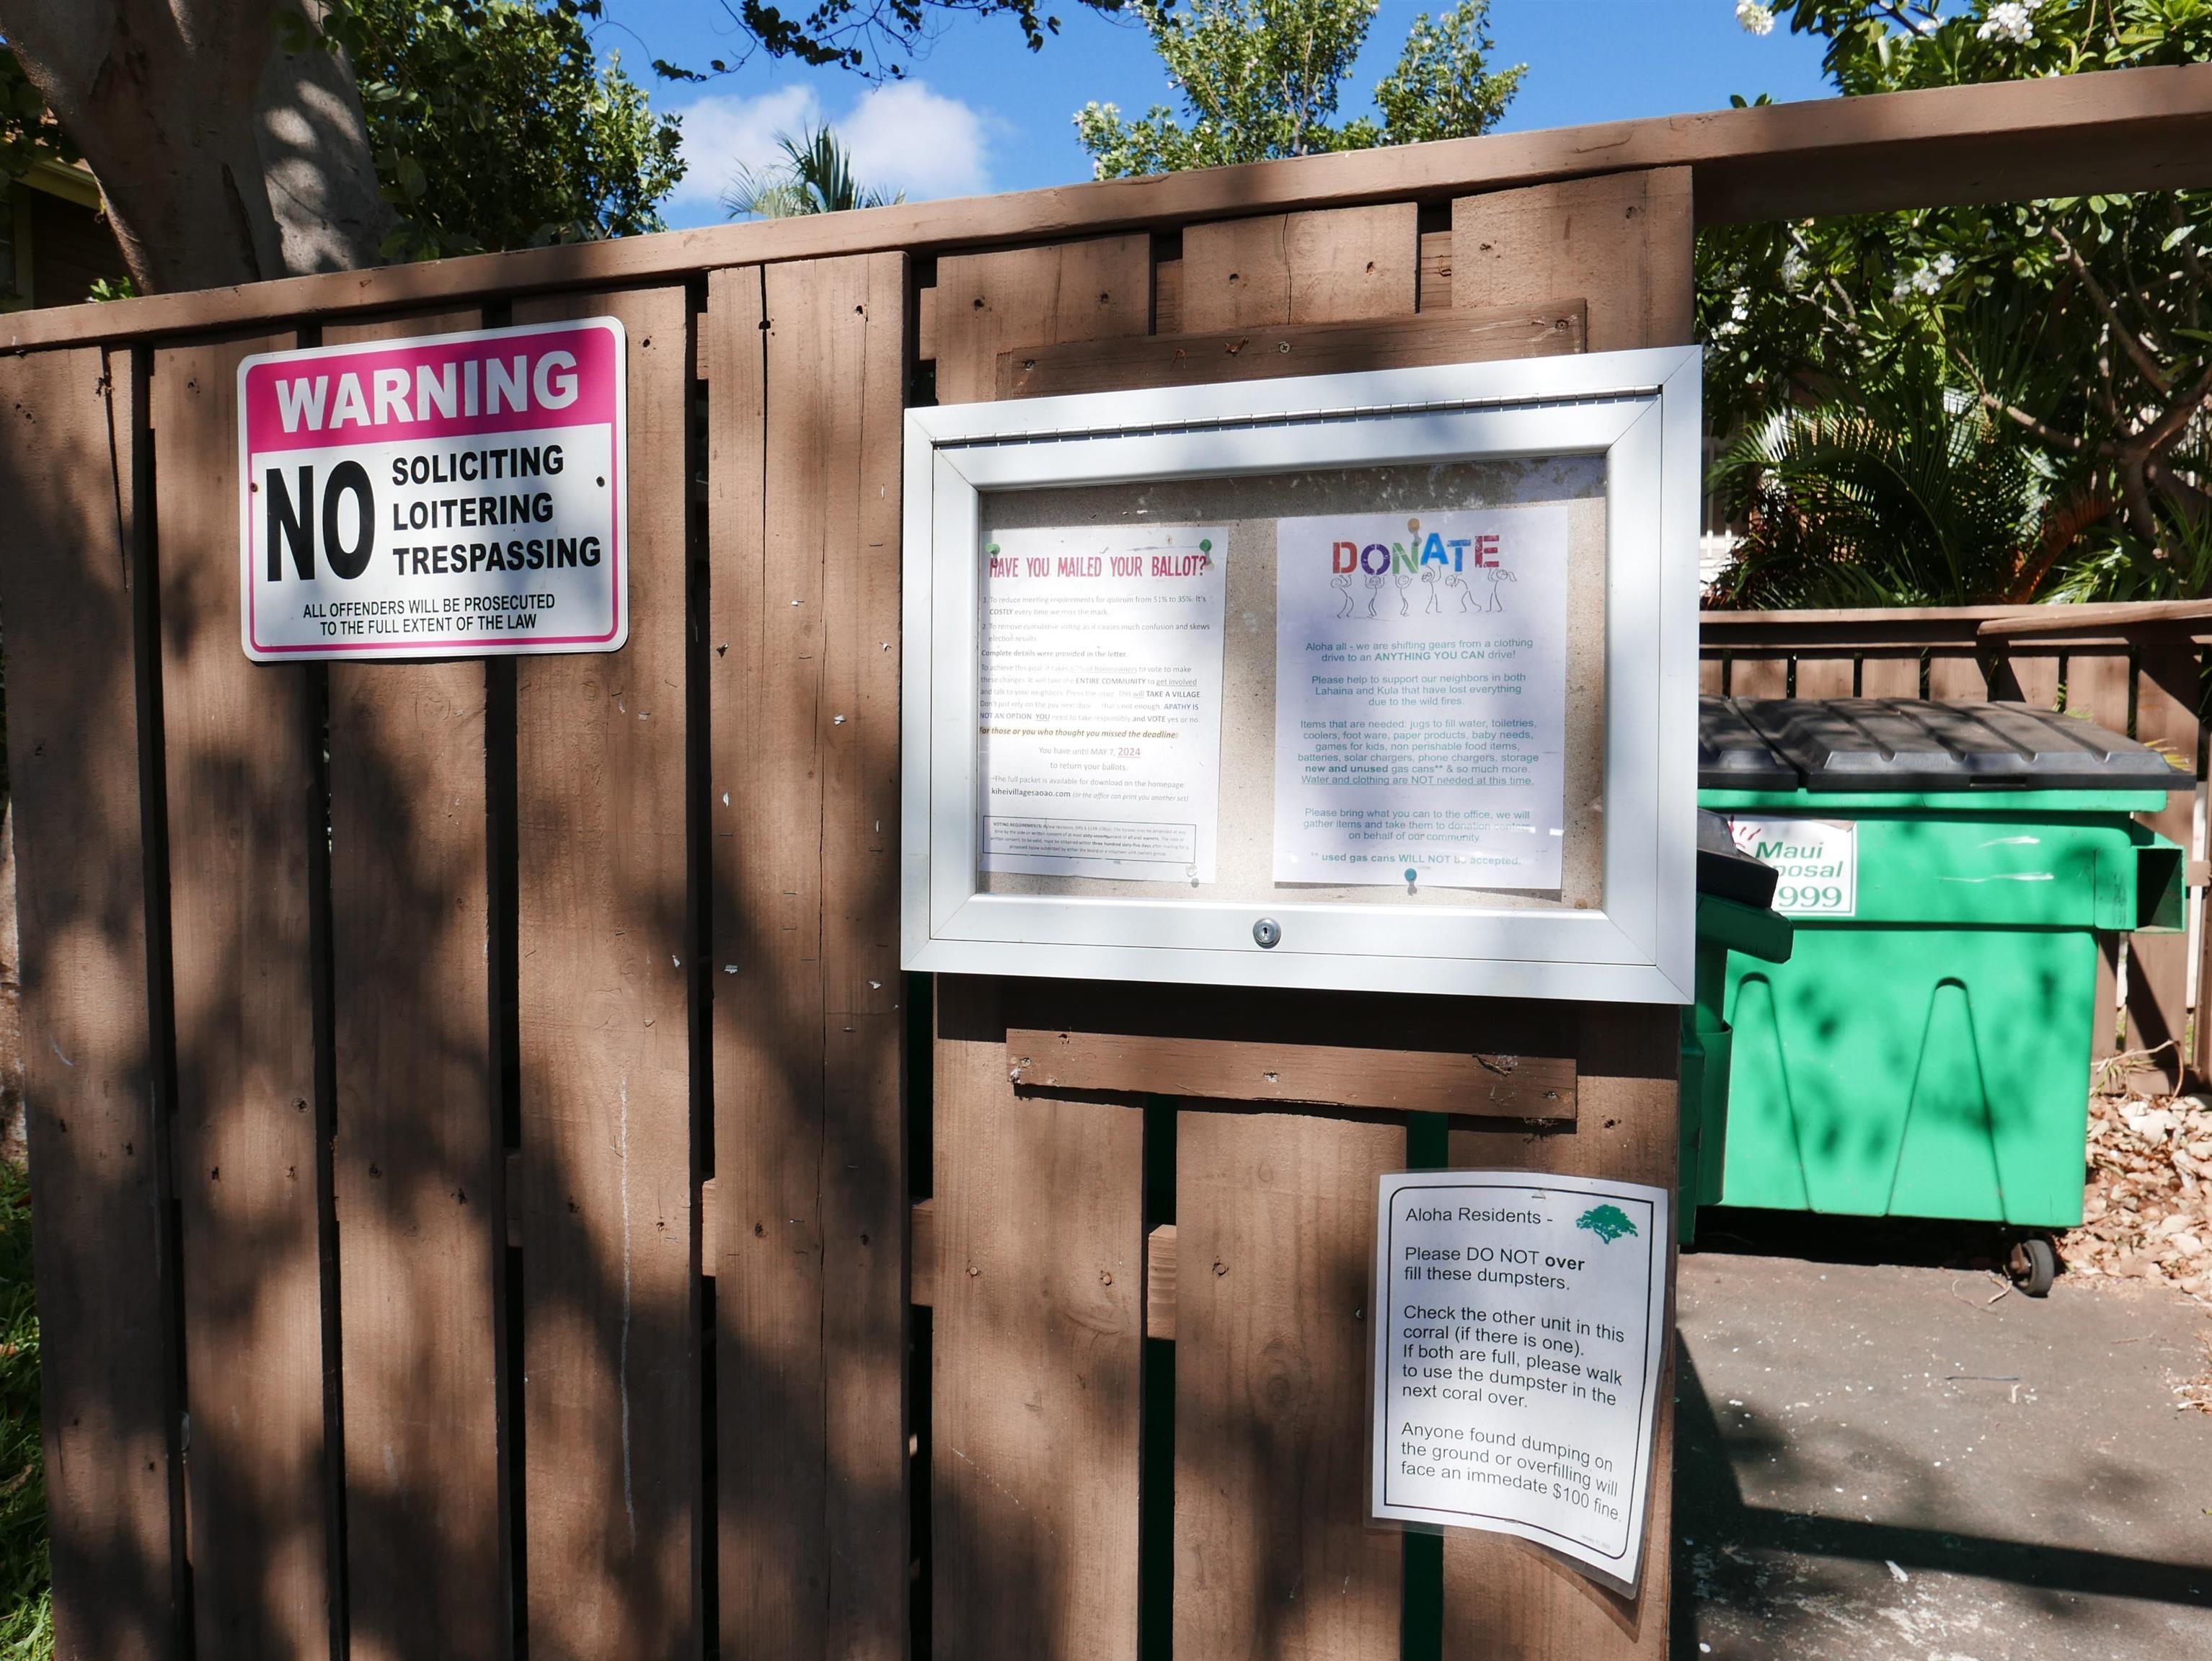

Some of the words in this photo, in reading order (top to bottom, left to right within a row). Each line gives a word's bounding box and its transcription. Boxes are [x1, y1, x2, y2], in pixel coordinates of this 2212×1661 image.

[275, 350, 578, 433] WARNING
[392, 445, 563, 486] SOLICITING
[266, 460, 375, 581] NO
[393, 492, 553, 531] LOITERING
[393, 536, 601, 575] TRESPASSING
[1333, 533, 1500, 575] DONATE
[990, 557, 1018, 577] HAVE
[1027, 557, 1049, 577] YOU
[1058, 557, 1102, 577] MAILED
[1110, 557, 1142, 577] YOUR
[1154, 556, 1206, 576] BALLOT?
[303, 603, 327, 618] ALL
[329, 601, 404, 617] OFFENDERS
[408, 599, 439, 614] WILL
[443, 598, 460, 612] BE
[464, 594, 554, 611] PROSECUTED
[320, 621, 337, 636] TO
[340, 620, 364, 634] THE
[368, 619, 399, 634] FULL
[403, 617, 452, 632] EXTENT
[456, 616, 474, 631] OF
[477, 615, 503, 630] THE
[508, 614, 536, 629] LAW
[1306, 642, 1333, 652] Aloha
[1336, 642, 1347, 651] all
[1392, 641, 1425, 651] shifting
[1428, 642, 1456, 651] gears
[1459, 639, 1482, 649] from
[1494, 638, 1533, 649] clothing
[1322, 653, 1345, 662] drive
[1374, 652, 1430, 661] ANYTHING
[1433, 650, 1457, 660] YOU
[1461, 650, 1485, 659] CAN
[1488, 648, 1516, 659] drive!
[1311, 676, 1344, 684] Please
[1347, 676, 1368, 686] help
[1371, 676, 1380, 684] to
[1382, 675, 1419, 685] support
[1440, 673, 1489, 684] neighbors
[1492, 673, 1501, 682] in
[1504, 673, 1526, 682] both
[1315, 686, 1353, 695] Lahaina
[1356, 686, 1376, 696] and
[1377, 686, 1399, 695] Kula
[1402, 686, 1420, 694] that
[1423, 686, 1446, 694] have
[1449, 685, 1467, 694] lost
[1469, 684, 1521, 695] everything
[1368, 697, 1386, 706] due
[1389, 697, 1399, 706] to
[1419, 696, 1438, 705] wild
[1056, 729, 1084, 738] thought
[1301, 720, 1327, 729] Items
[1368, 719, 1407, 729] needed:
[1409, 720, 1430, 730] jugs
[1433, 719, 1443, 728] to
[1446, 719, 1456, 727] fill
[1458, 719, 1488, 729] water,
[1492, 718, 1536, 728] toiletries,
[992, 788, 1070, 797] kiheivillagesaoao.com
[1756, 842, 1823, 859] Maui
[1405, 1208, 1452, 1221] Aloha
[1459, 1208, 1541, 1224] Residents
[1406, 1247, 1461, 1260] Please
[1467, 1247, 1494, 1262] DO
[1500, 1249, 1539, 1264] NOT
[1545, 1257, 1585, 1271] over
[1404, 1266, 1421, 1280] fill
[1427, 1266, 1472, 1280] these
[1477, 1267, 1570, 1290] dumpsters.
[1404, 1305, 1456, 1320] Check
[1461, 1307, 1487, 1321] the
[1492, 1310, 1536, 1326] other
[1541, 1317, 1571, 1332] unit
[1577, 1319, 1590, 1336] in
[1596, 1324, 1624, 1342] this
[1403, 1325, 1448, 1339] corral
[1455, 1326, 1471, 1343] (if
[1475, 1328, 1518, 1345] there
[1524, 1332, 1536, 1347] is
[1542, 1339, 1583, 1358] one).
[1404, 1344, 1414, 1357] If
[1419, 1344, 1454, 1359] both
[1460, 1350, 1486, 1362] are
[1492, 1349, 1519, 1368] full,
[1527, 1355, 1580, 1376] please
[1586, 1367, 1622, 1386] walk
[1402, 1364, 1417, 1377] to
[1423, 1368, 1452, 1379] use
[1458, 1367, 1483, 1381] the
[1490, 1369, 1567, 1394] dumpster
[1573, 1382, 1585, 1399] in
[1592, 1387, 1616, 1406] the
[1403, 1385, 1437, 1398] next
[1443, 1388, 1482, 1401] coral
[1488, 1393, 1527, 1407] over.
[1402, 1422, 1464, 1440] Anyone
[1469, 1427, 1516, 1446] found
[1521, 1435, 1589, 1467] dumping
[1595, 1457, 1612, 1472] on
[1402, 1441, 1426, 1456] the
[1432, 1447, 1489, 1463] ground
[1495, 1454, 1512, 1466] or
[1518, 1455, 1591, 1489] overfilling
[1596, 1479, 1618, 1497] will
[1402, 1461, 1435, 1476] face
[1441, 1468, 1461, 1479] an
[1468, 1468, 1547, 1494] immedate
[1552, 1483, 1589, 1508] $100
[1594, 1498, 1622, 1521] fine.
